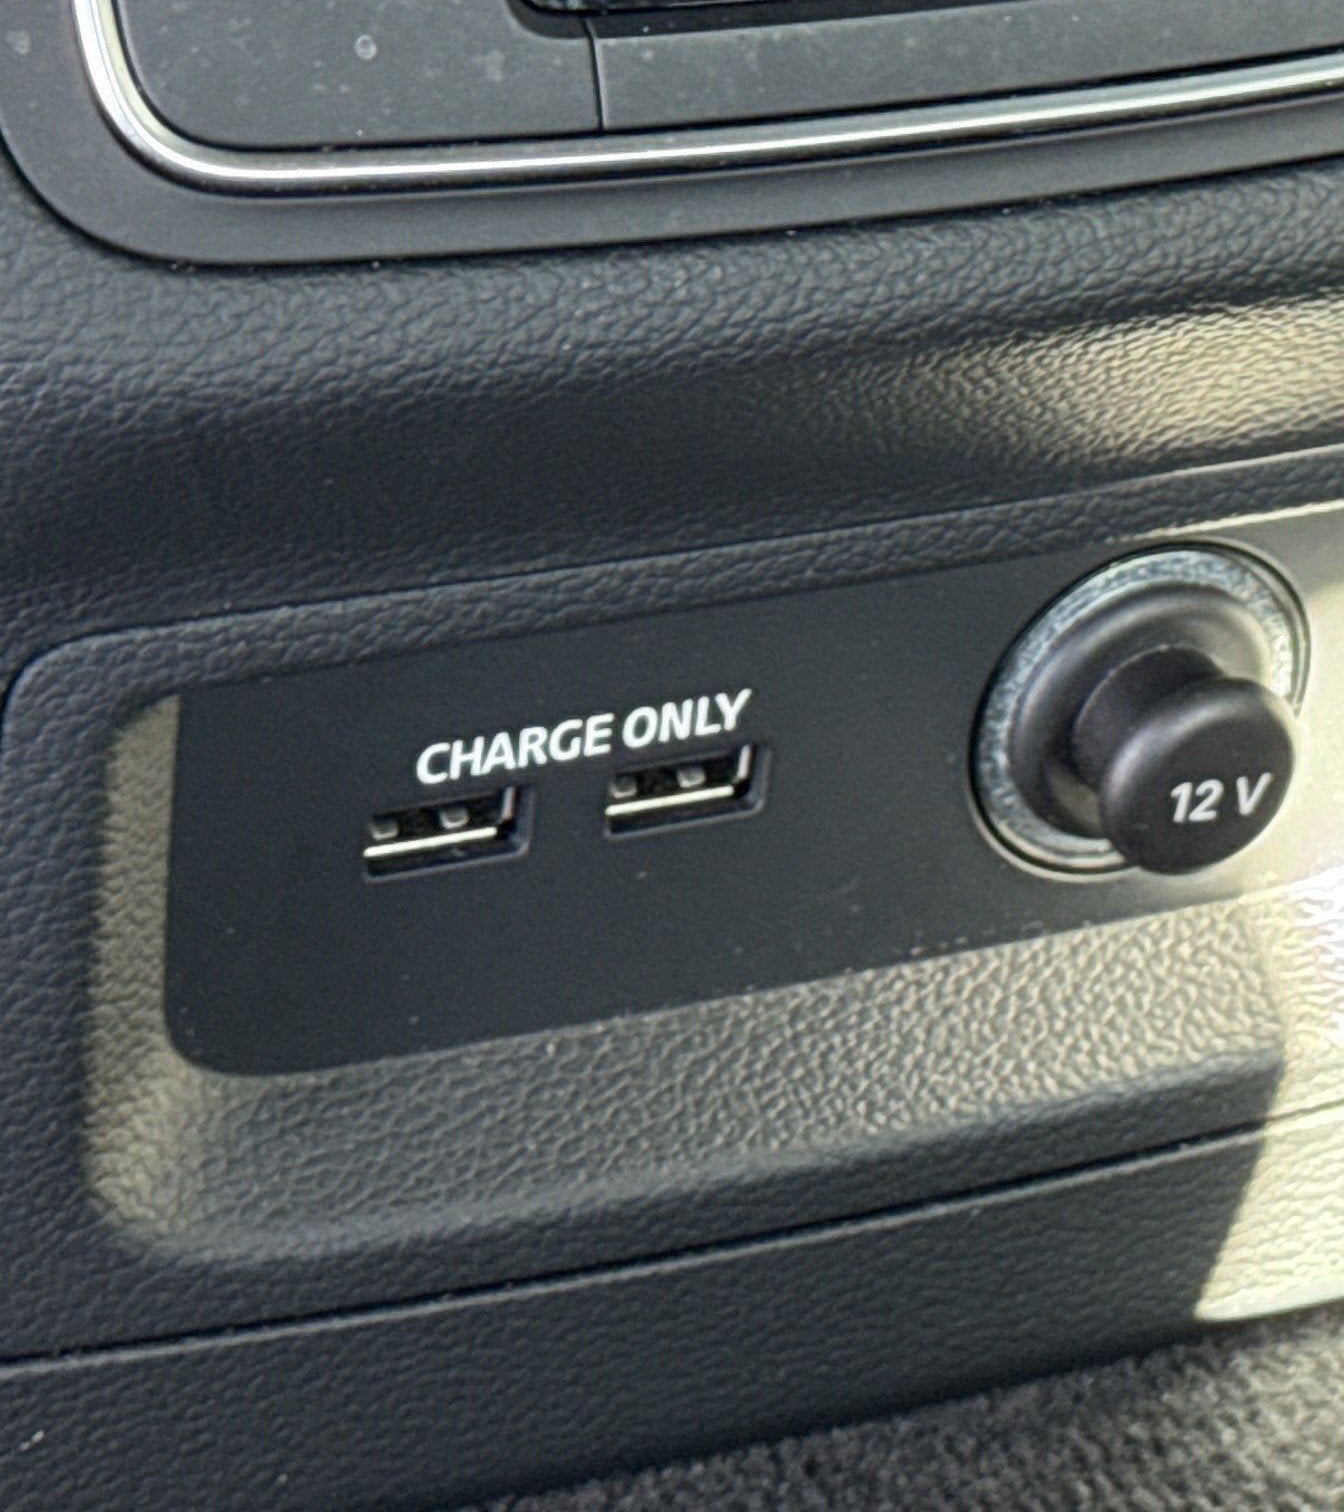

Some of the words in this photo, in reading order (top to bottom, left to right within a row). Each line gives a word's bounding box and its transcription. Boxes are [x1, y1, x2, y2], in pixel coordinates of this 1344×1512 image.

[414, 711, 616, 786] CHARGE
[620, 687, 753, 750] ONLY
[1169, 777, 1225, 824] 12
[1236, 772, 1274, 818] V
